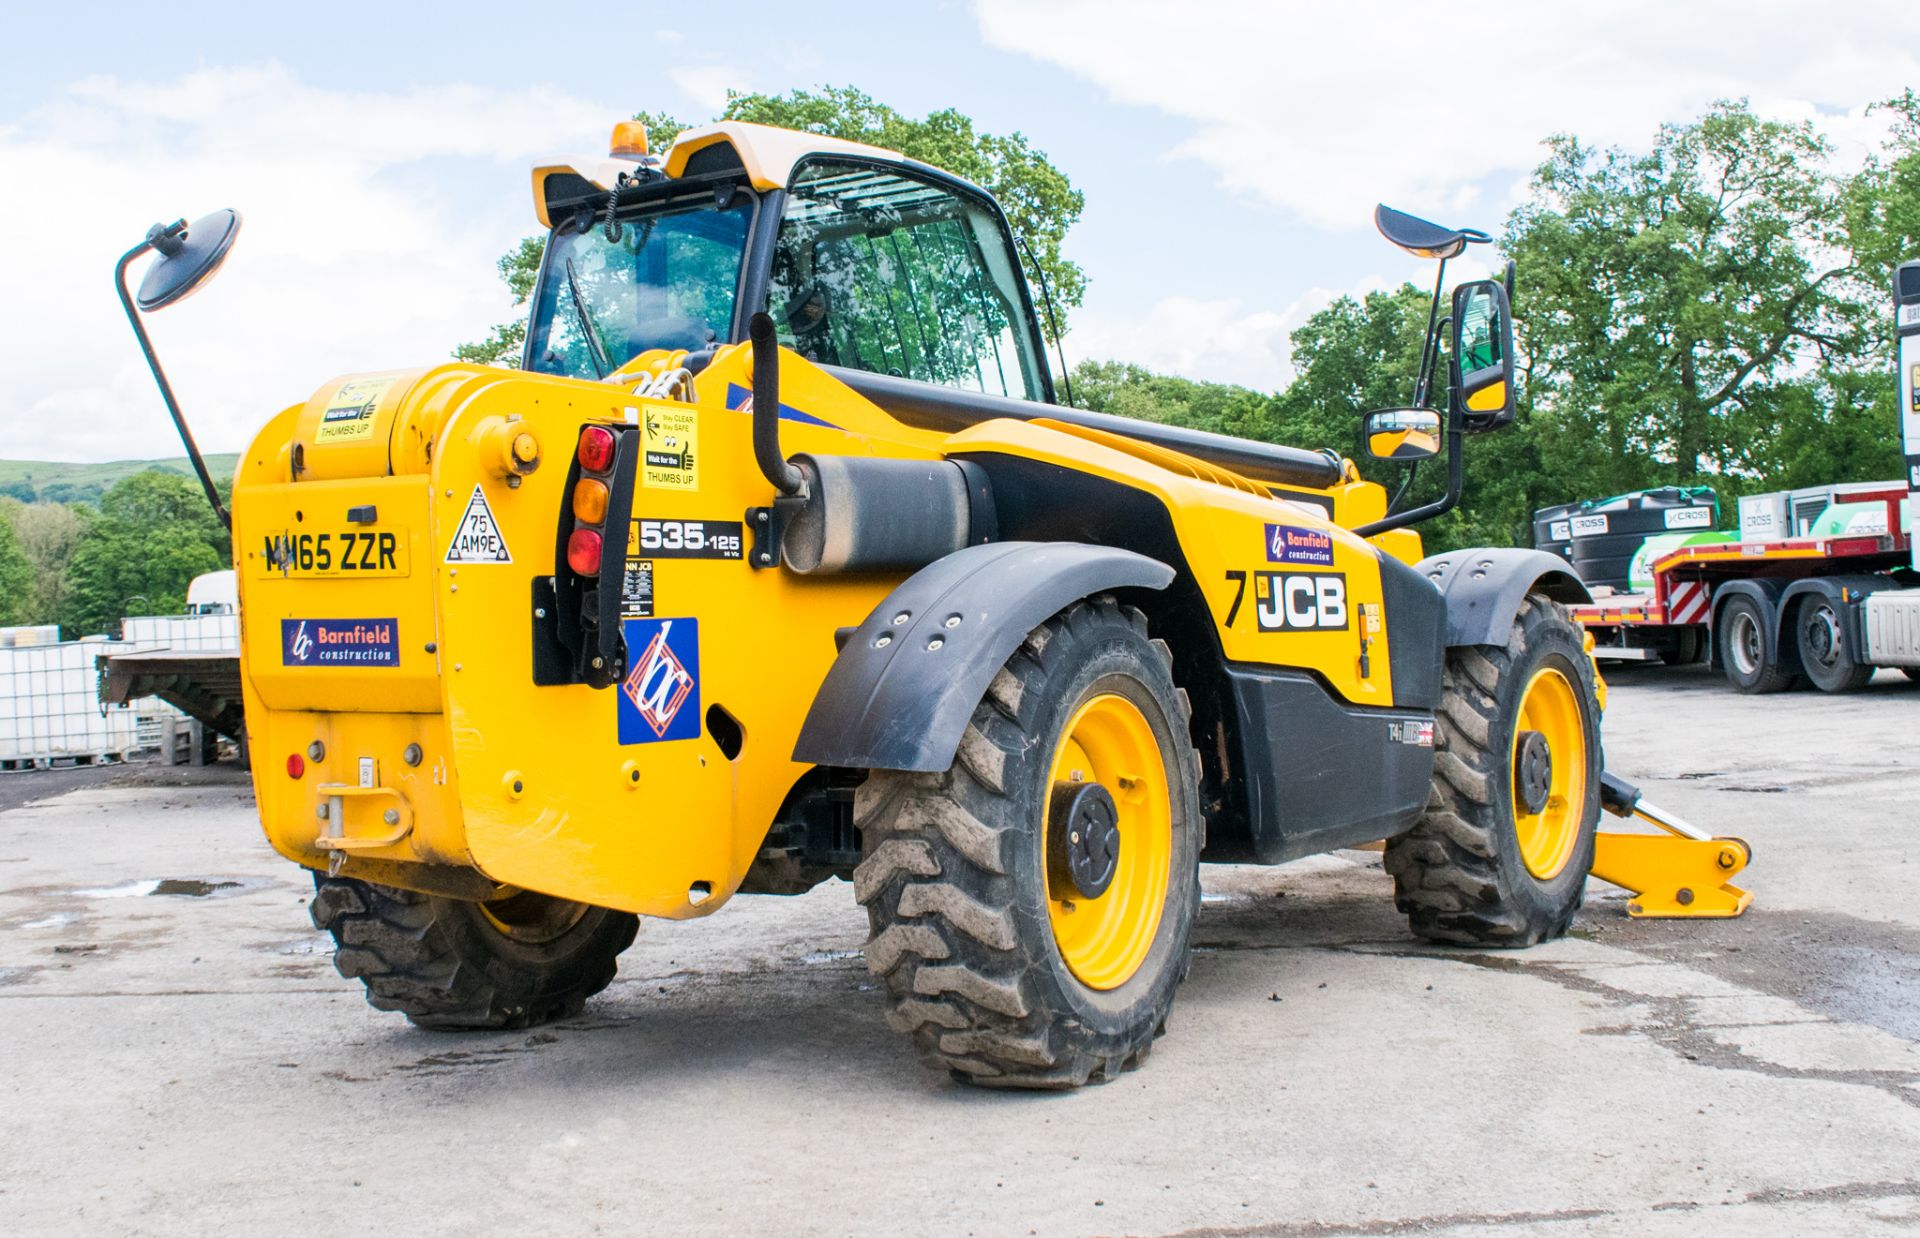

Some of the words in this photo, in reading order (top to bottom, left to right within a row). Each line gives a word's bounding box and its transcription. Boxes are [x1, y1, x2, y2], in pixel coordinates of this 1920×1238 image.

[674, 414, 694, 424] CLEAR
[321, 425, 356, 437] THUMBS
[357, 423, 369, 434] UP
[674, 423, 689, 432] SAFE
[647, 455, 660, 464] Wait
[660, 456, 669, 464] for
[669, 457, 678, 465] the
[647, 471, 681, 484] THUMBS
[682, 474, 694, 485] UP
[470, 515, 488, 534] 75
[1575, 518, 1605, 529] CROSS
[1745, 514, 1771, 527] CROSS
[461, 534, 497, 553] AM9E
[1287, 531, 1329, 549] Barnfield
[340, 532, 397, 571] ZZR
[1288, 550, 1330, 562] construction
[625, 562, 638, 571] NN
[1224, 570, 1247, 629] 7
[1258, 575, 1347, 628] JCB
[318, 624, 391, 644] Barnfield
[319, 648, 392, 661] construction
